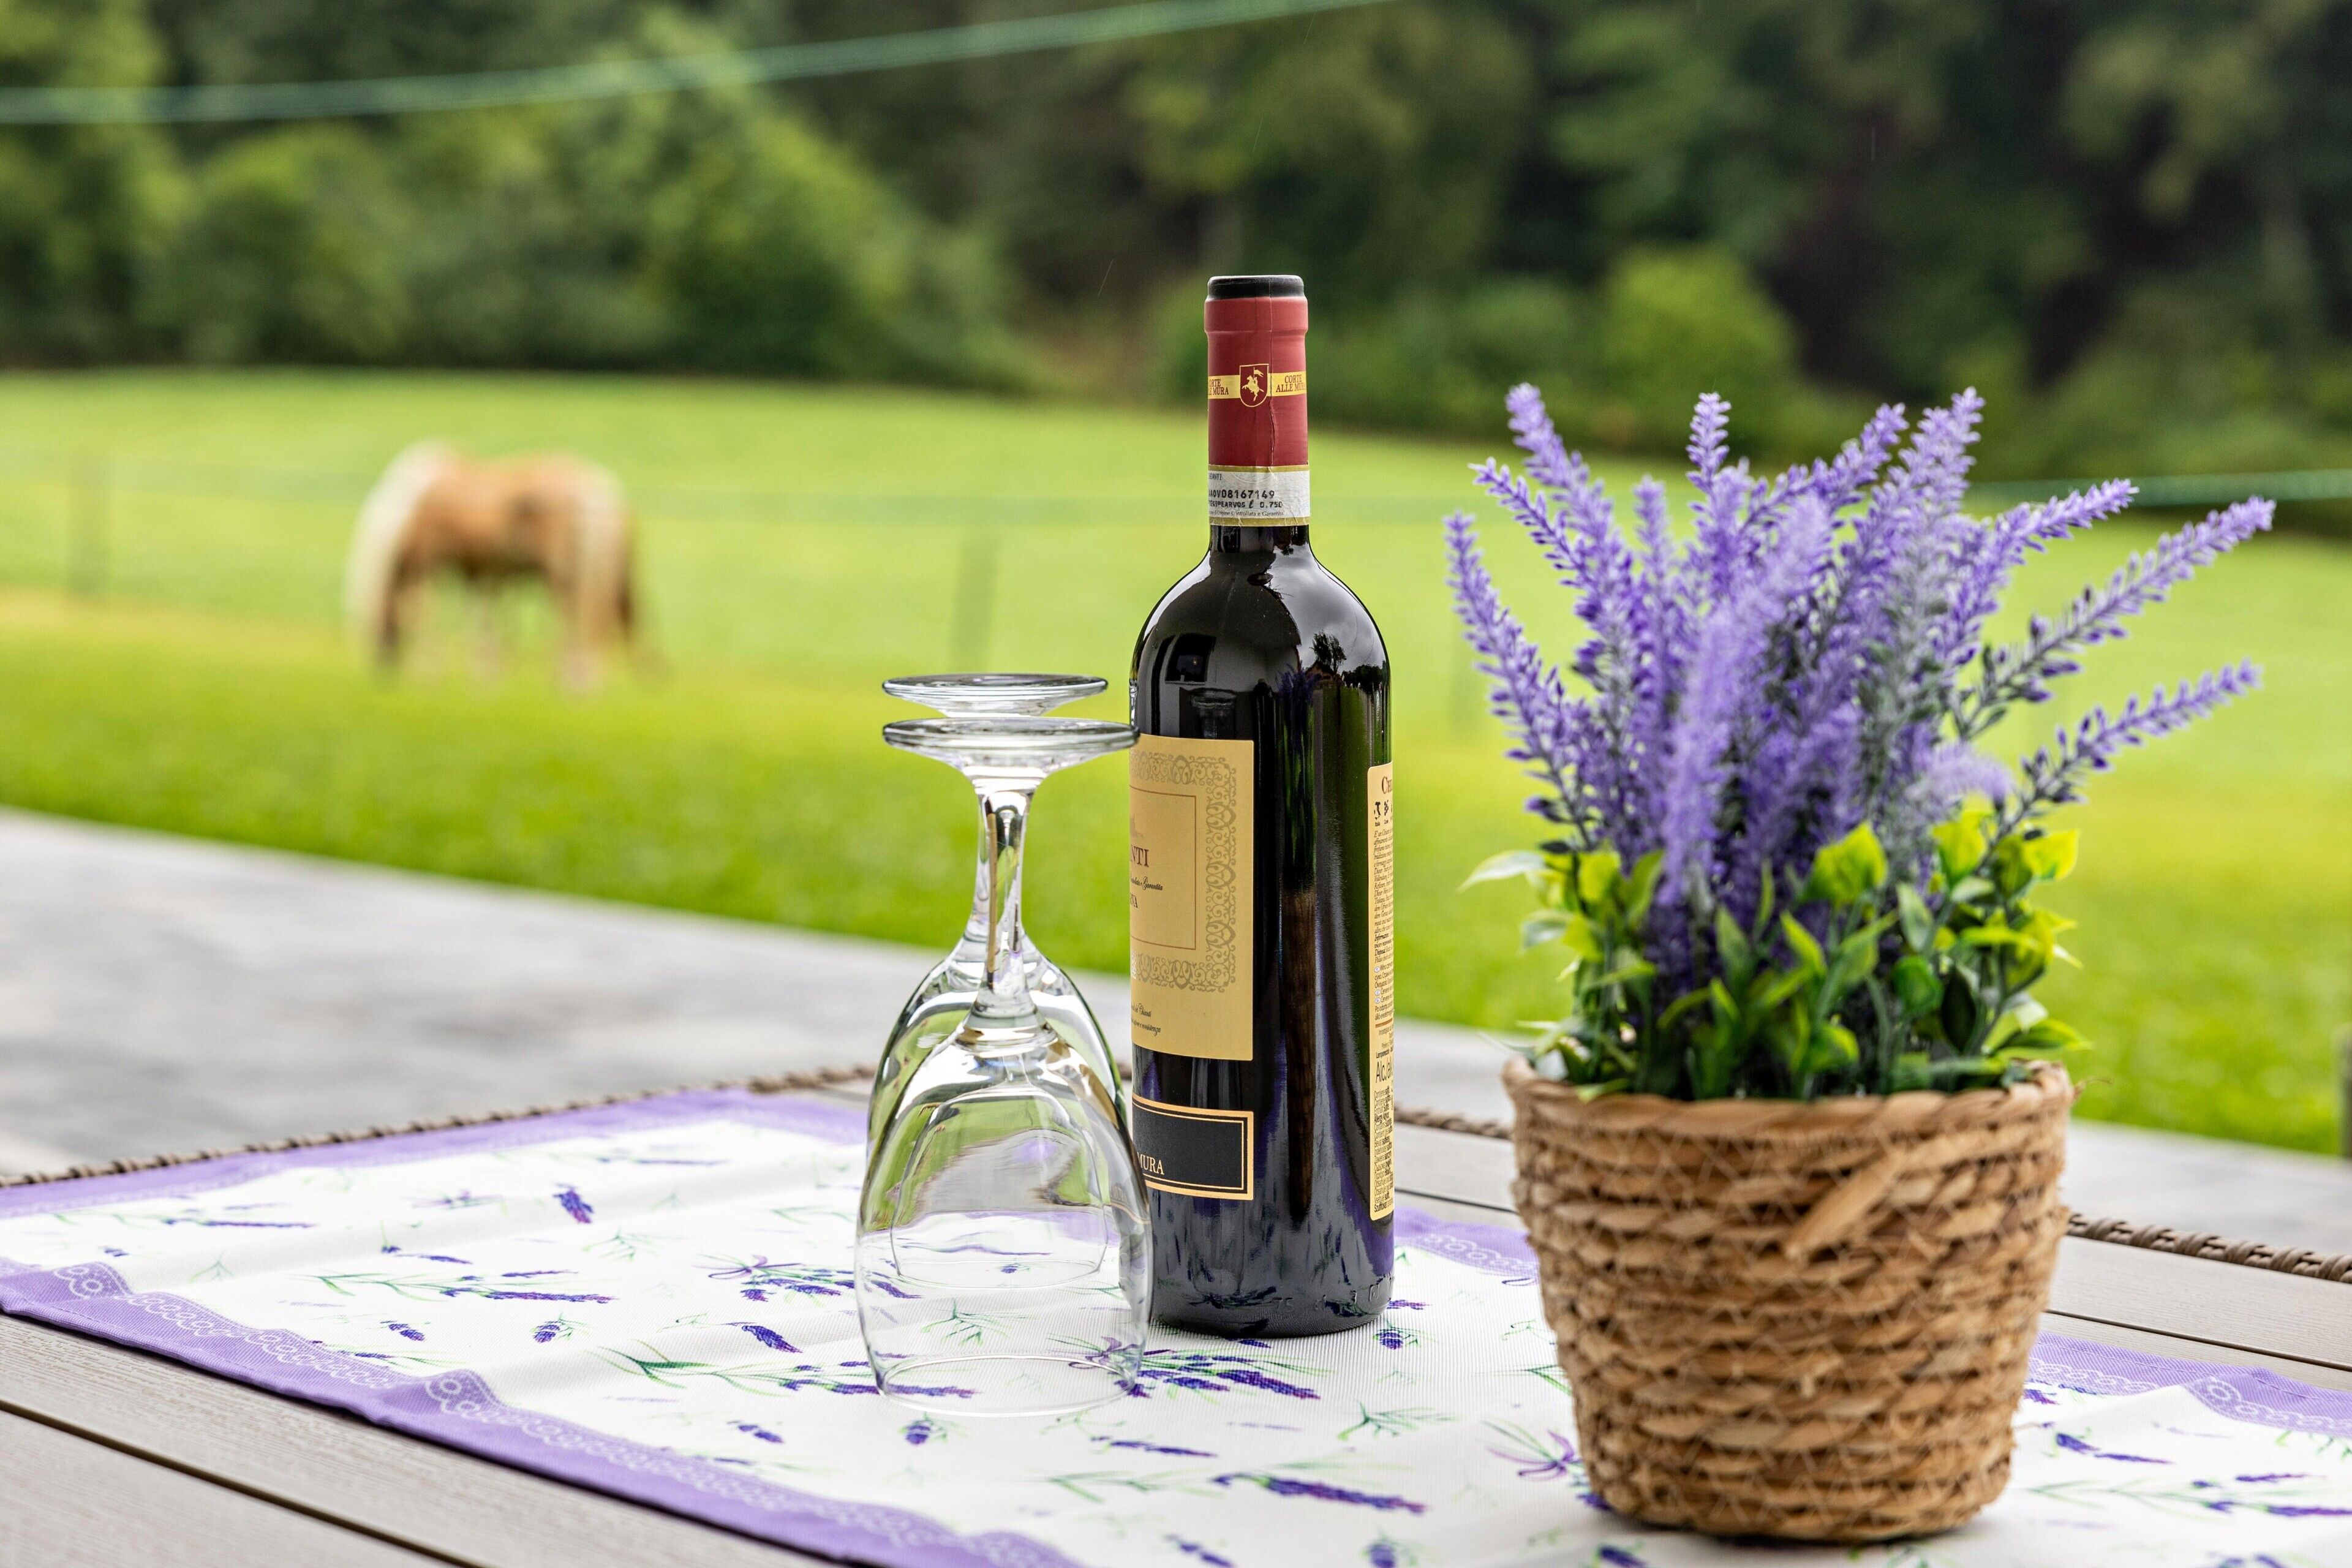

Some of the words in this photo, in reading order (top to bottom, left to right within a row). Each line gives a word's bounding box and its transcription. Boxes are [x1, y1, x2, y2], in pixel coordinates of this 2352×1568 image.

[1284, 374, 1302, 384] CORTE
[1212, 386, 1229, 395] MURA
[1276, 384, 1293, 393] ALLE
[1142, 876, 1163, 891] Garantita
[1137, 1152, 1165, 1175] MURA
